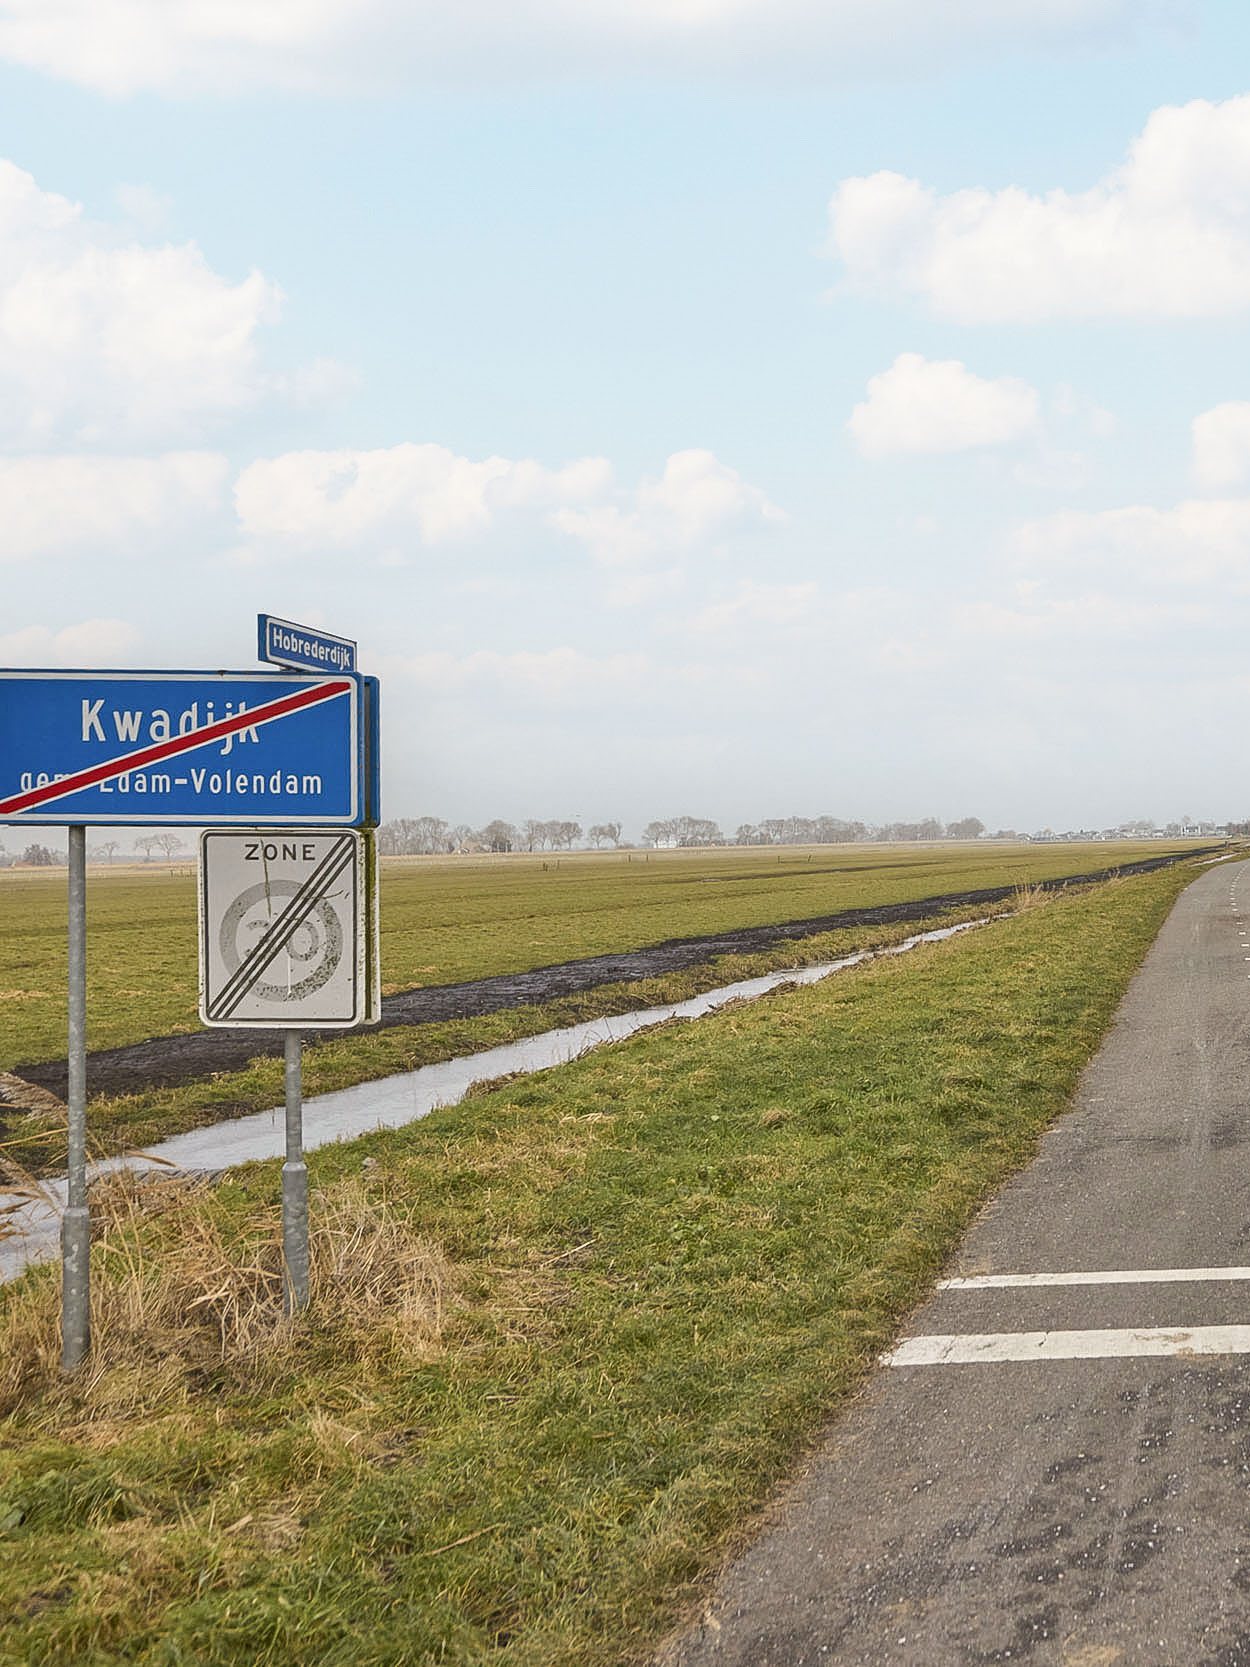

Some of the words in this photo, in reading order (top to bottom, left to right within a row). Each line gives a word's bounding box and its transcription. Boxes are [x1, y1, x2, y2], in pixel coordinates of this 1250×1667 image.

[273, 627, 350, 671] Hobrederdijk
[81, 699, 260, 756] Kwadijk
[244, 843, 316, 861] ZONE
